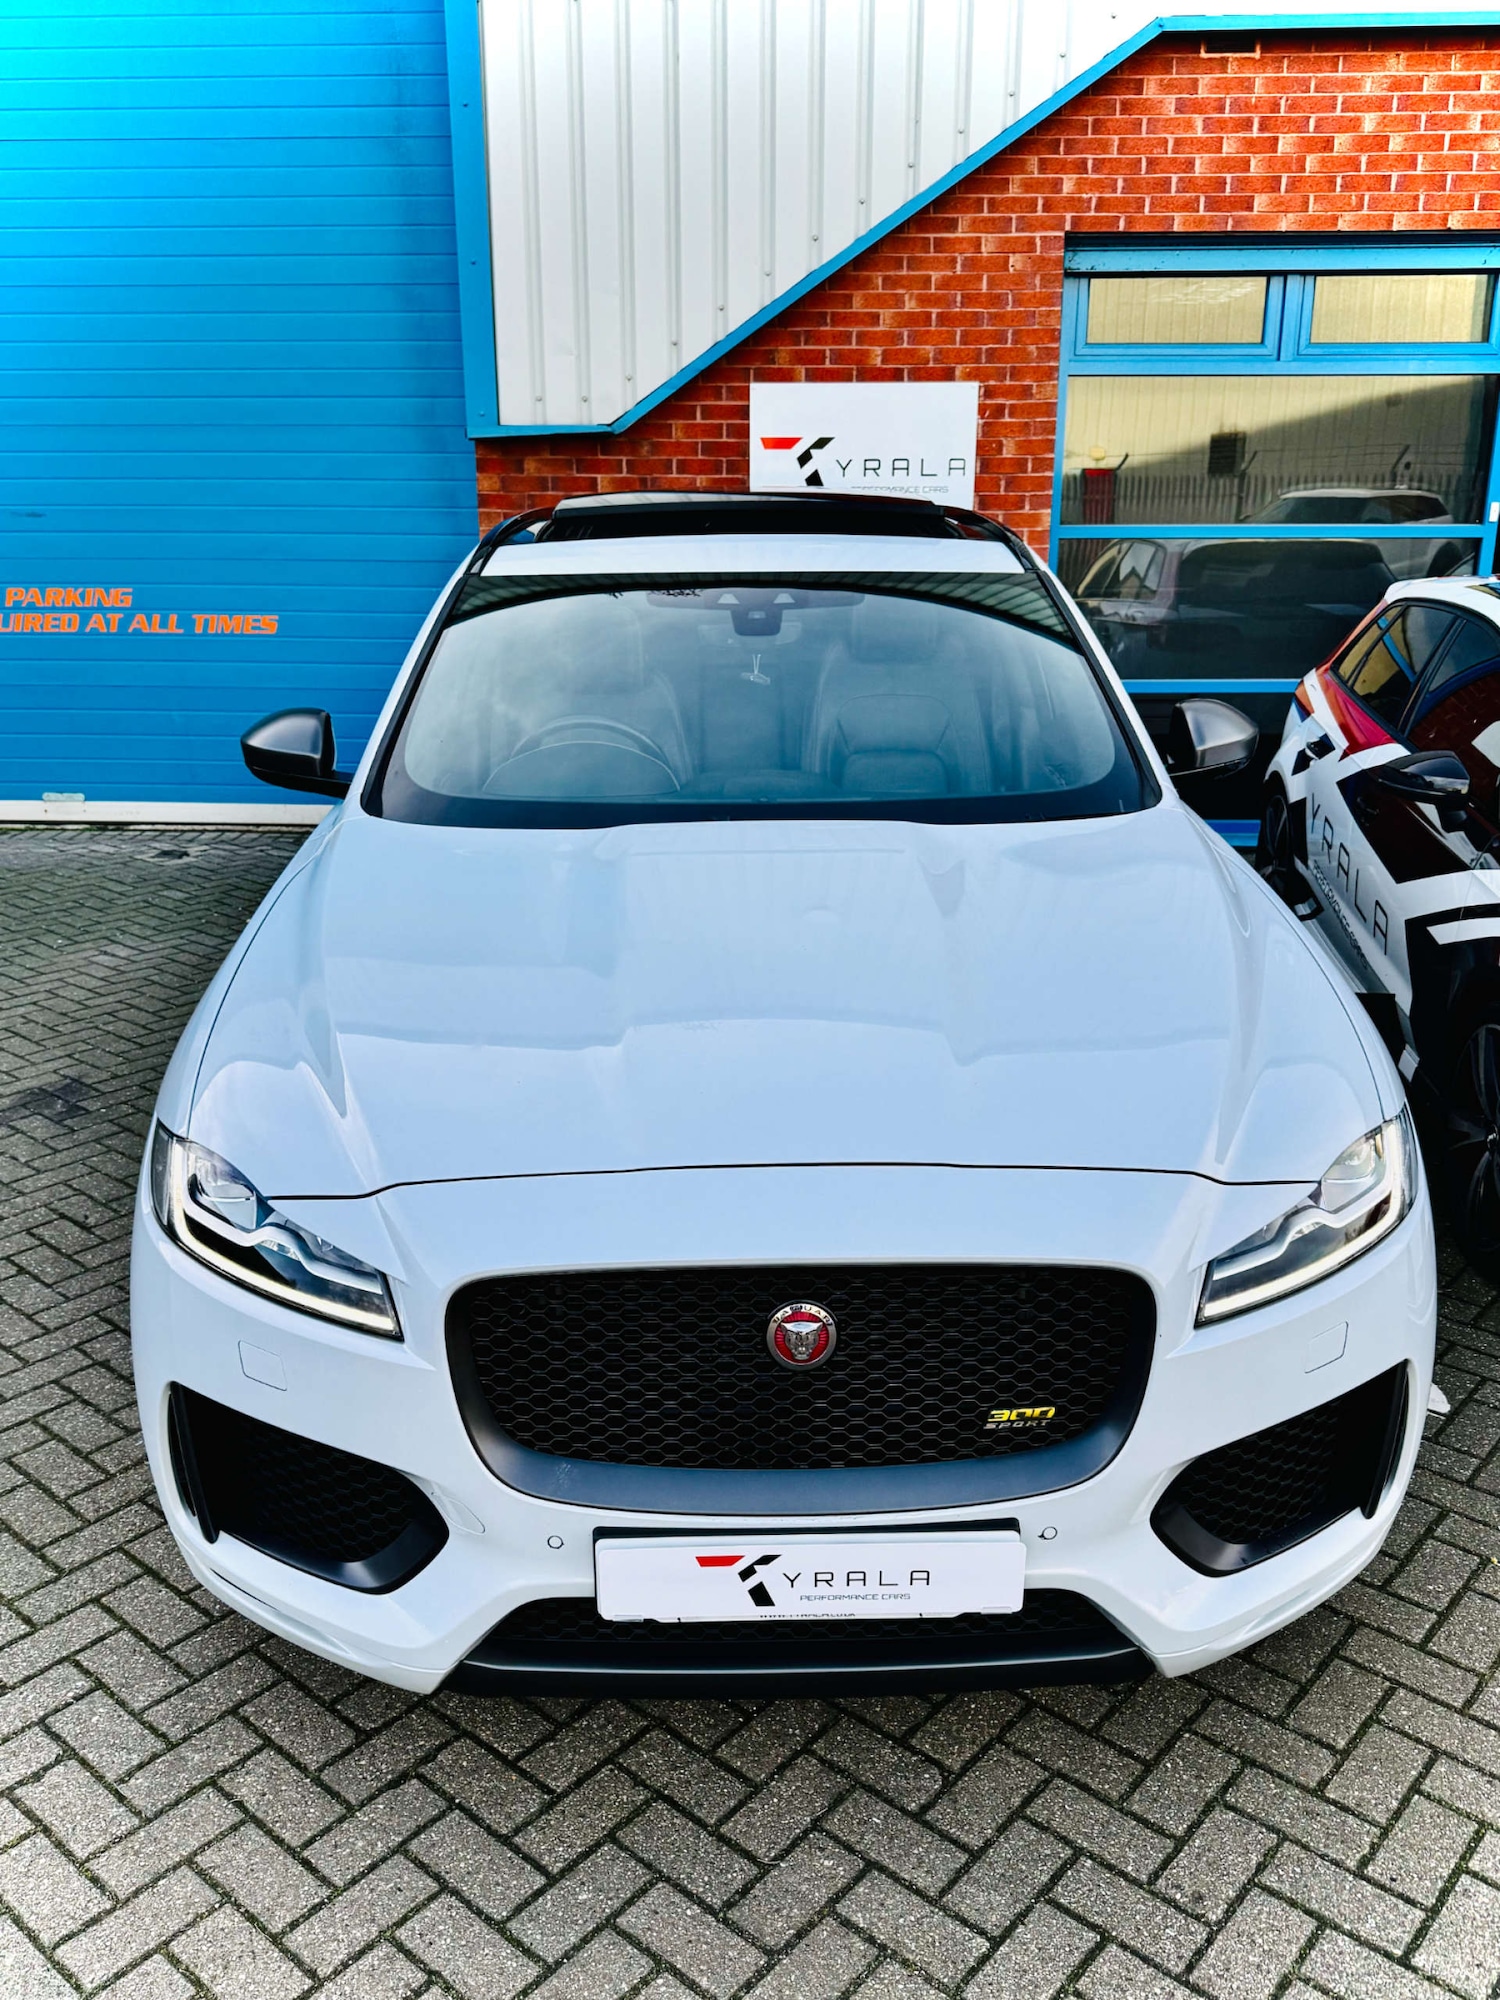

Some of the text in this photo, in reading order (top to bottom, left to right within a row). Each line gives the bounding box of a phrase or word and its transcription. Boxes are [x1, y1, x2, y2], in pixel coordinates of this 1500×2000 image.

[5, 588, 133, 607] PARKING
[85, 614, 123, 632] AT
[128, 614, 184, 633] ALL
[192, 614, 279, 634] TIMES
[772, 1304, 833, 1326] JAGUAR
[987, 1406, 1056, 1422] 300
[983, 1420, 1051, 1430] SPORT
